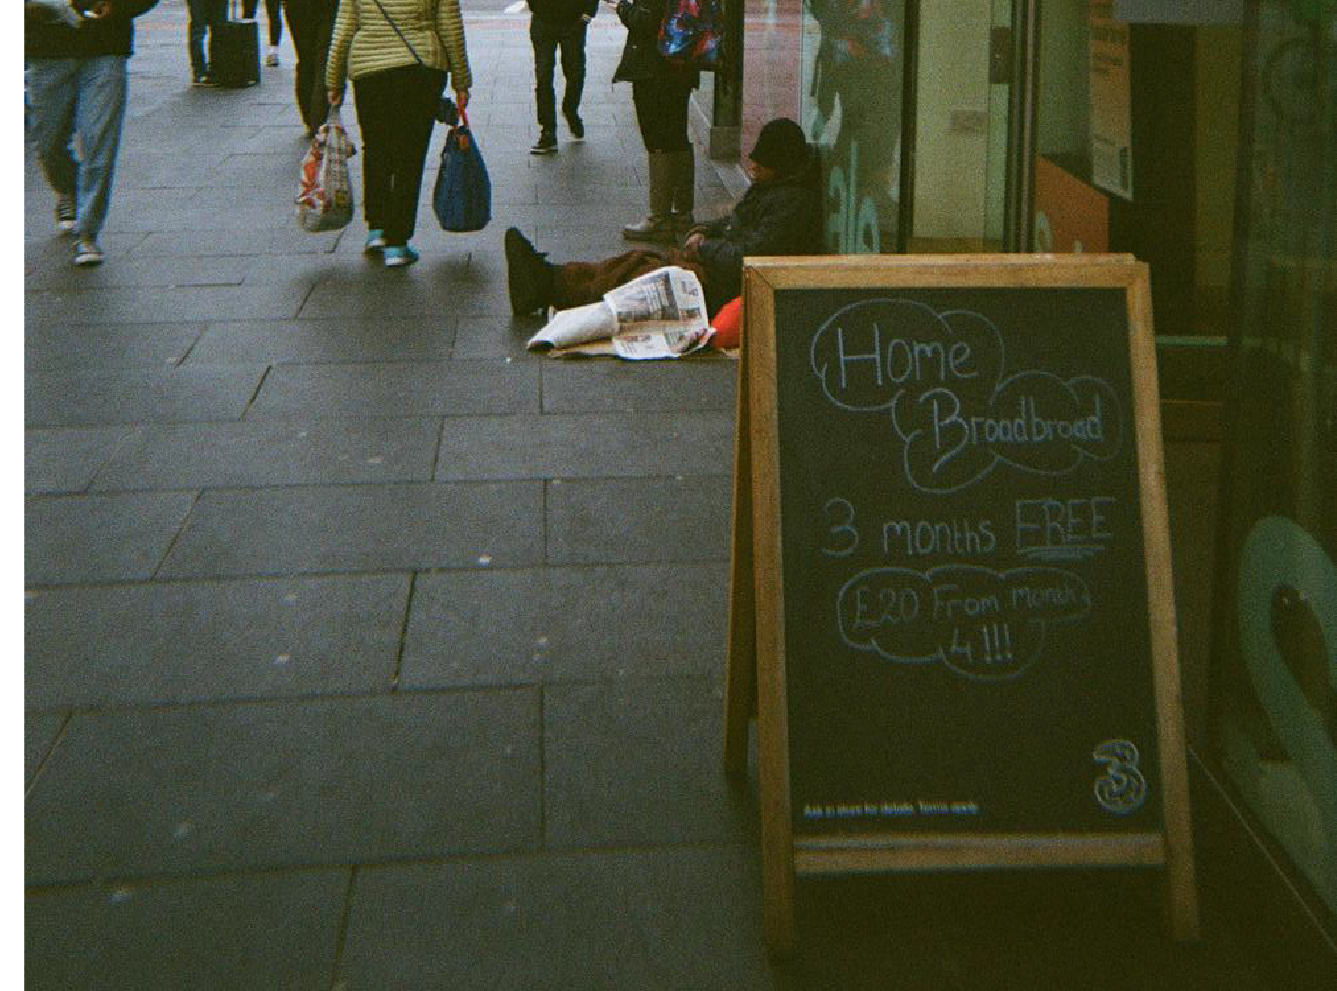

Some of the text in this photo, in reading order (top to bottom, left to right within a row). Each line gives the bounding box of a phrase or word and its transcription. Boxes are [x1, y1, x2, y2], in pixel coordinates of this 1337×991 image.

[836, 322, 979, 389] Home
[822, 495, 1117, 558] 3 months FREE
[932, 583, 999, 619] From
